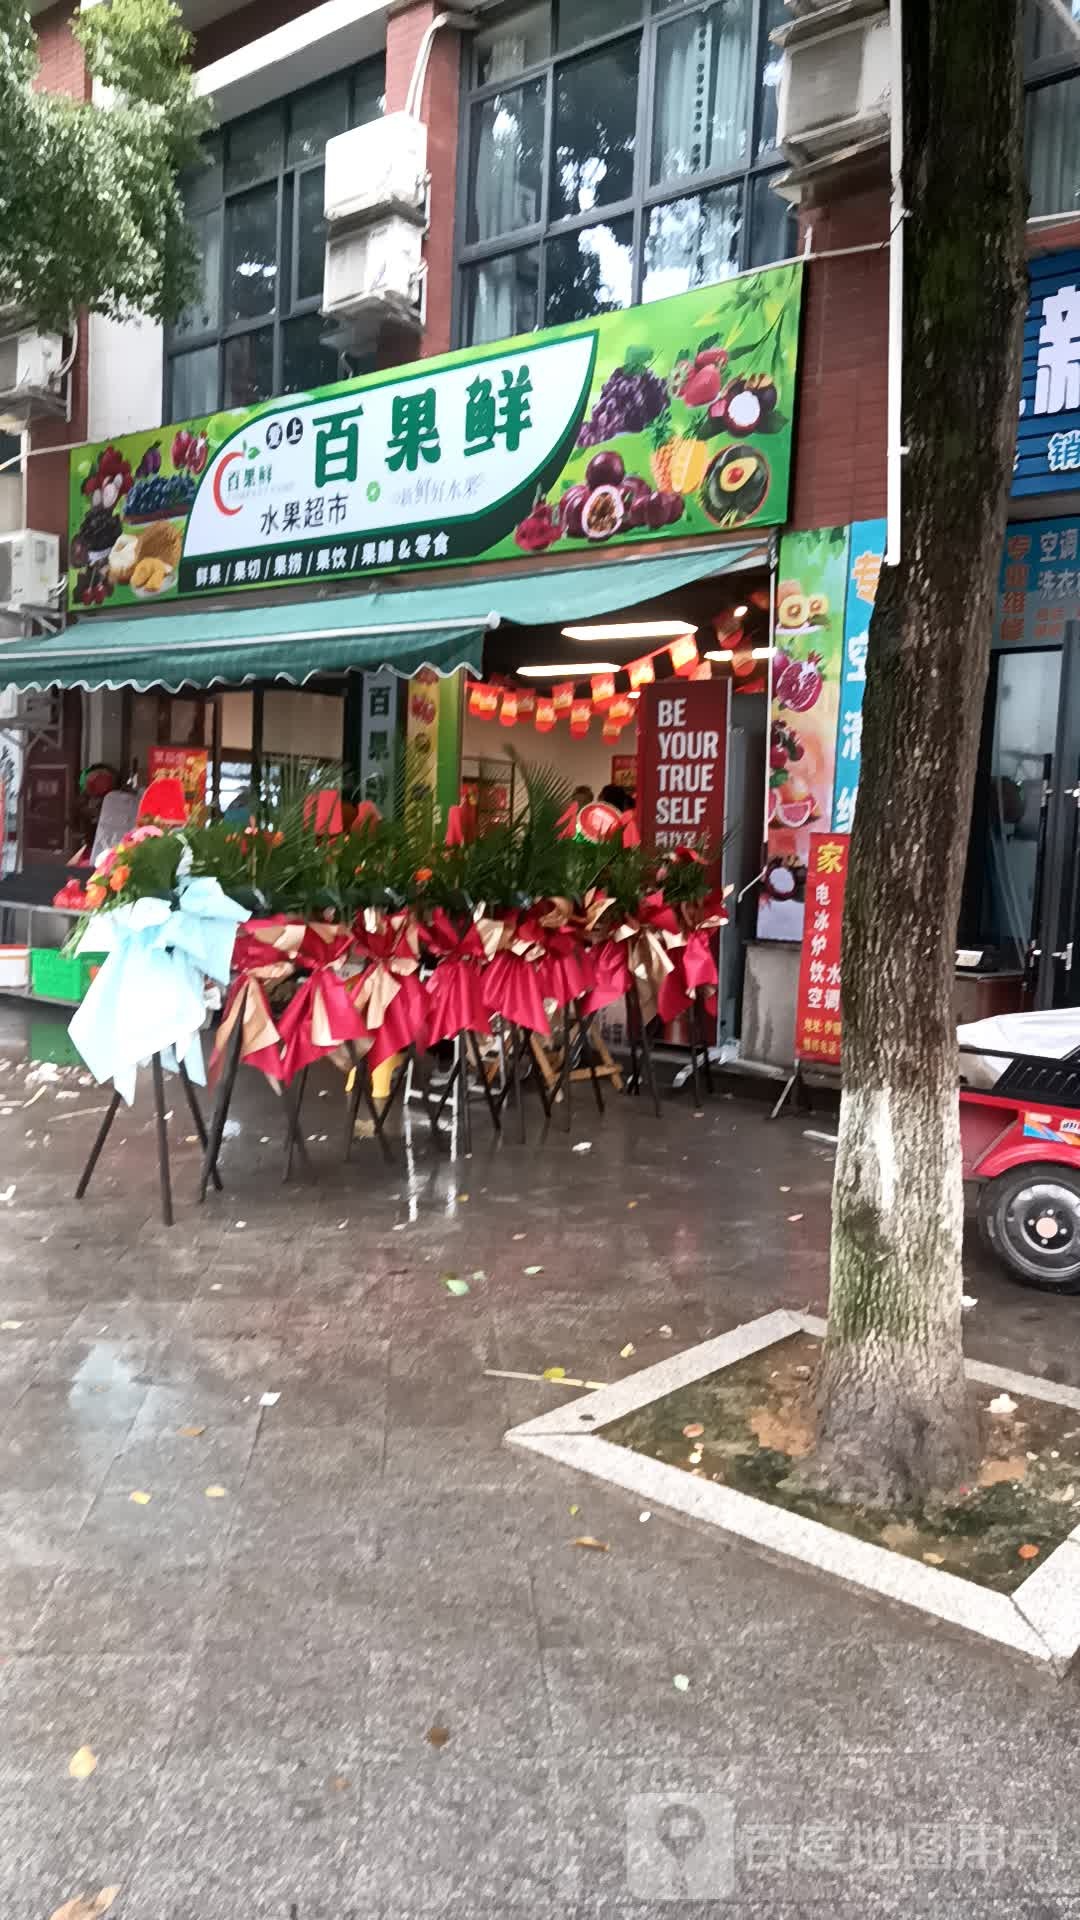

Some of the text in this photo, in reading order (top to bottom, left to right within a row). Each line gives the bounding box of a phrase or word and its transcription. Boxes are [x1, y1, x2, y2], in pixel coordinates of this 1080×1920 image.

[313, 364, 532, 488] 百果鲜
[228, 464, 272, 491] 百果鲜
[260, 492, 349, 536] 水果超市
[657, 699, 688, 727] BE
[658, 731, 719, 759] YOUR
[657, 764, 714, 792] TRUE
[656, 797, 707, 825] SELF
